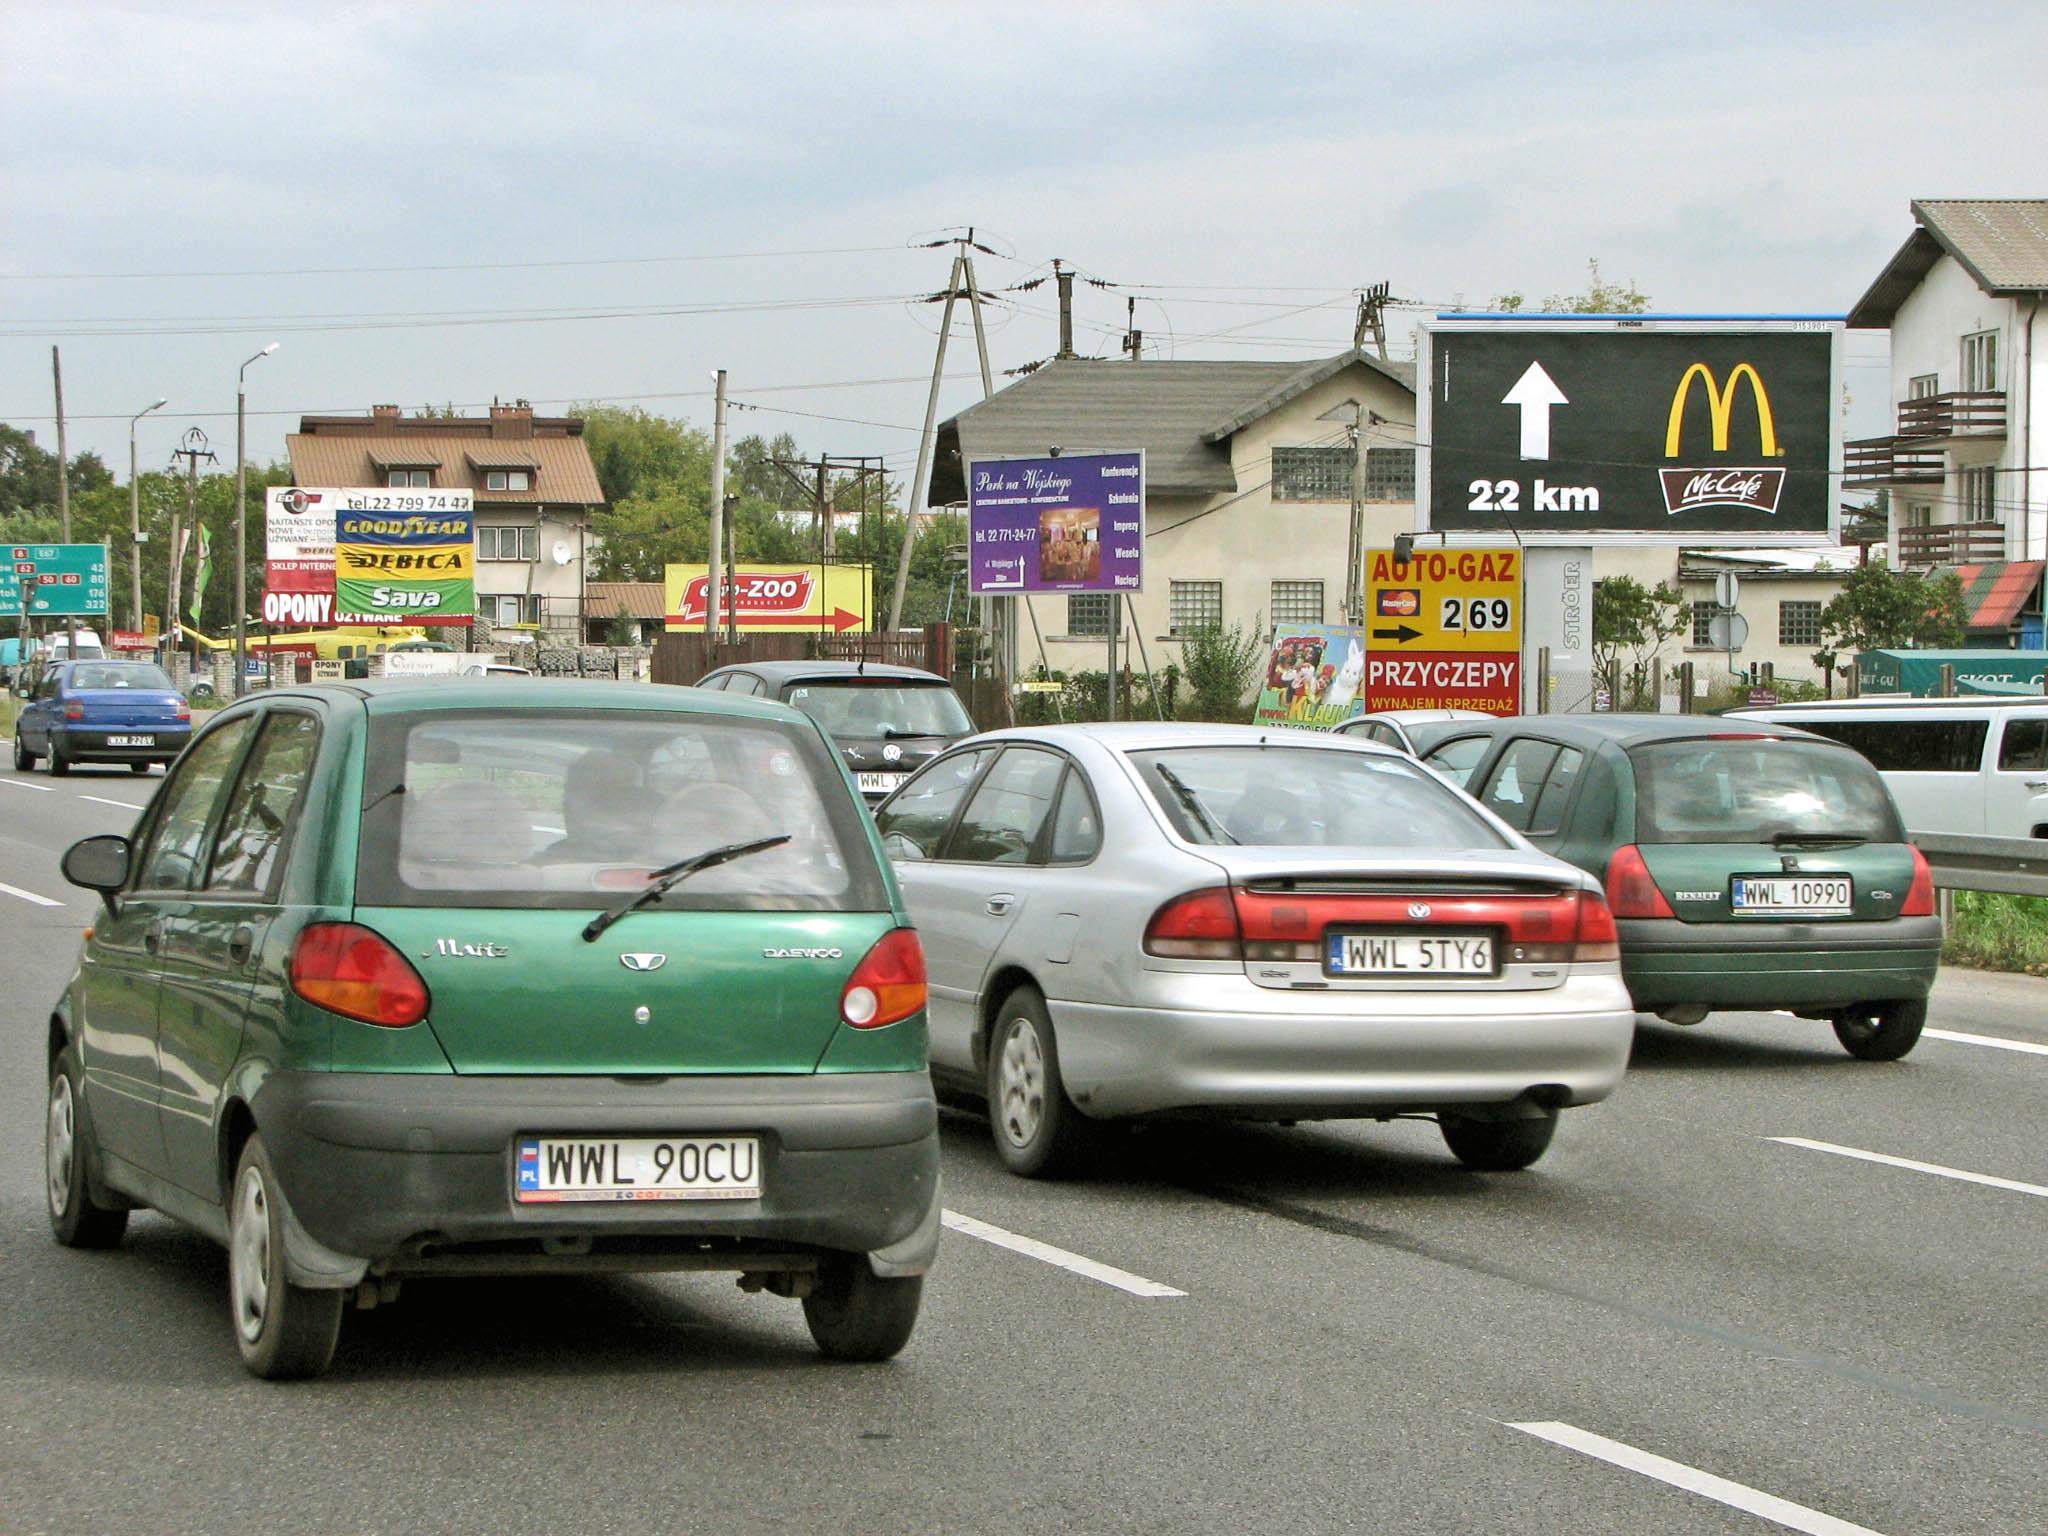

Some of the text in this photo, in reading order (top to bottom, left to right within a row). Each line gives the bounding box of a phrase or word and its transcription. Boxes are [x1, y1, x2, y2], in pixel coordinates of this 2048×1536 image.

[1101, 466, 1139, 478] Konferencje
[975, 468, 1073, 497] Park na Wojskiego
[1682, 470, 1763, 499] McCafé
[1108, 493, 1139, 505] Szkolenia
[1467, 479, 1600, 511] 22 km
[396, 497, 424, 510] 799
[1113, 520, 1139, 533] Imprezy
[975, 528, 1037, 542] tel. 22 771-24-77
[90, 563, 105, 573] 42
[271, 562, 298, 571] SKLEP
[1372, 553, 1515, 582] AUTO-GAZ
[90, 574, 105, 584] 80
[1114, 575, 1139, 587] Noclegi
[88, 588, 105, 598] 176
[371, 586, 442, 607] Sava
[85, 600, 105, 609] 322
[264, 593, 332, 622] OPONY
[1561, 561, 1581, 650] STRÖER
[314, 661, 342, 669] OPONY
[1369, 661, 1515, 687] PRZYCZEPY
[1371, 697, 1435, 710] WYNAJEM
[1444, 696, 1513, 711] SPRZEDAŻ
[860, 774, 889, 788] WWL
[1675, 891, 1721, 901] RENAULT
[1744, 883, 1783, 905] WWL
[1791, 883, 1847, 905] 10990
[763, 948, 843, 959] DAEWOO
[1347, 939, 1409, 970] WWL
[1419, 938, 1488, 970] 5TY6
[521, 1142, 754, 1185] PL WWL 90CU
